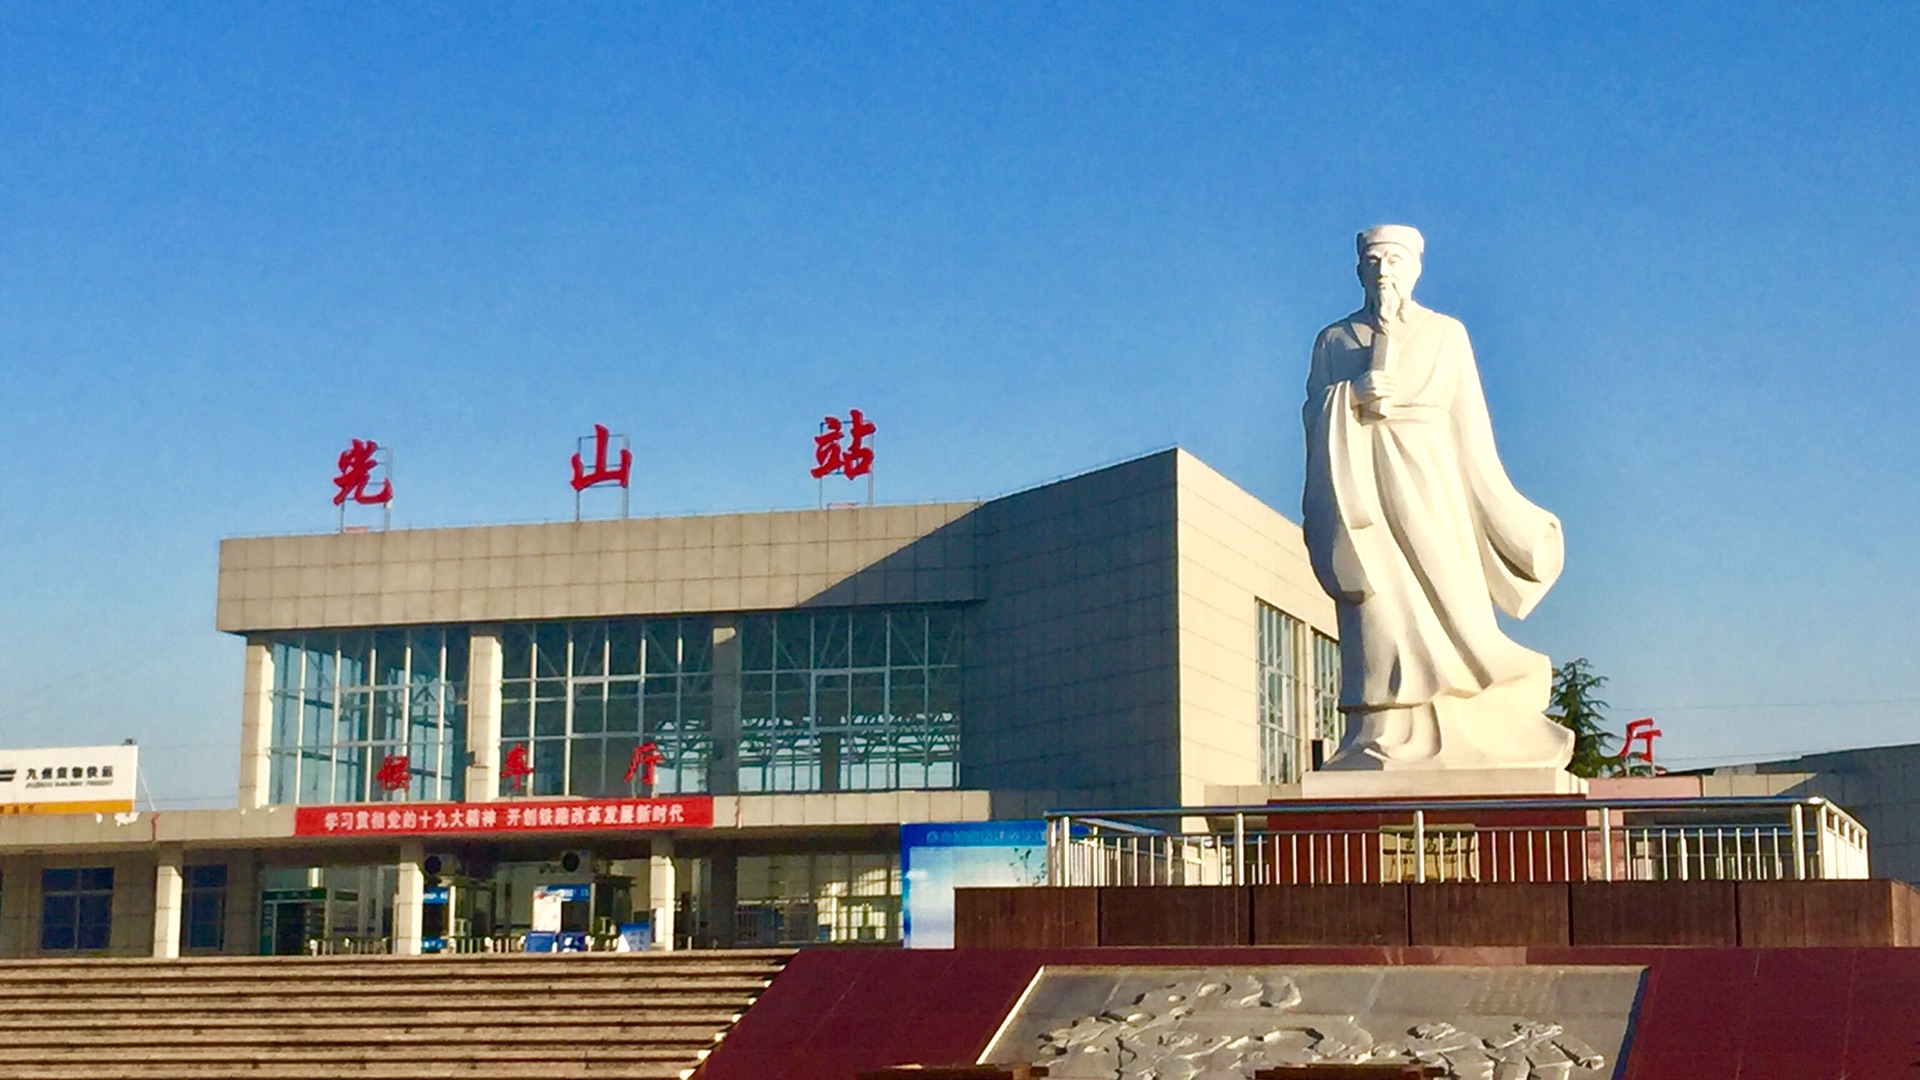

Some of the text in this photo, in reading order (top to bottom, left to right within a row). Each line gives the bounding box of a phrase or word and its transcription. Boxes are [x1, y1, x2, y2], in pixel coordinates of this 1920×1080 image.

[333, 408, 876, 505] 光山站
[1616, 717, 1662, 763] 厅
[324, 803, 685, 831] 学习贯彻党的十九大精神 开创铁路改革发展新时代
